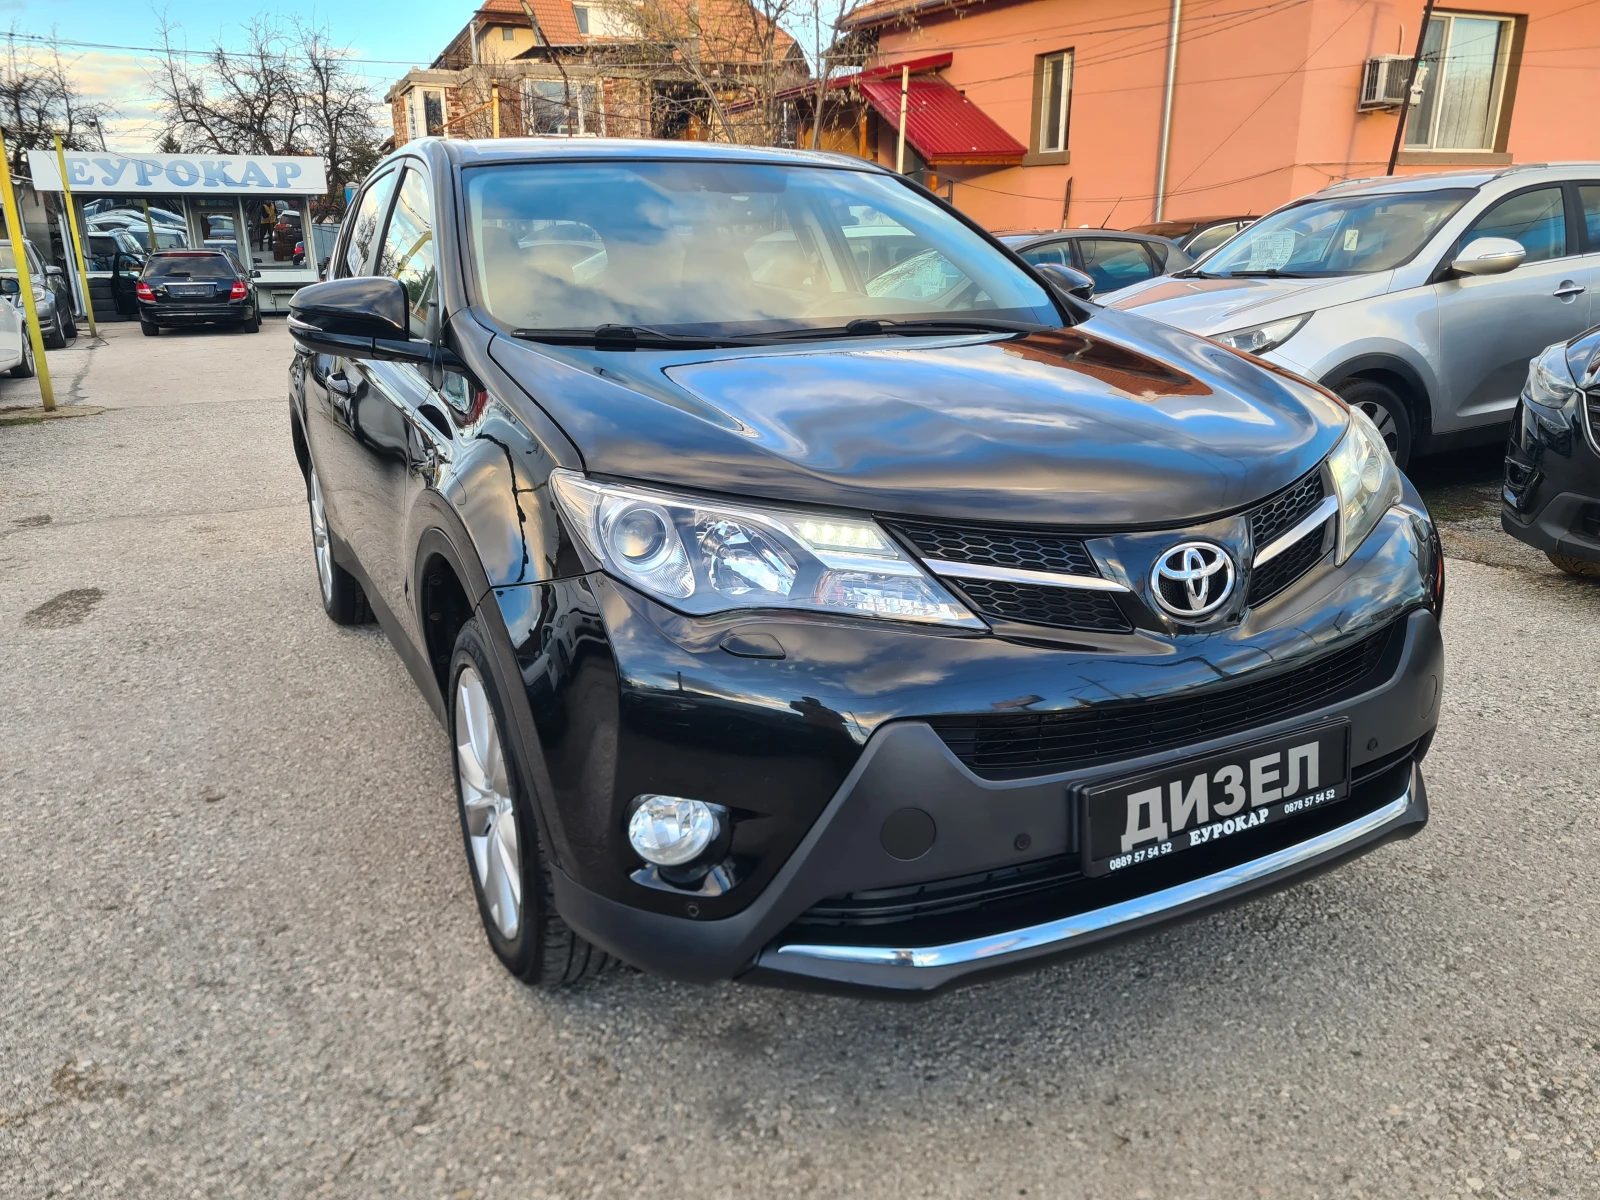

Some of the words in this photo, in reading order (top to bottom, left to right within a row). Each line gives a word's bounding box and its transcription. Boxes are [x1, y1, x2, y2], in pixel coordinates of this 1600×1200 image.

[66, 157, 302, 188] ЕУРОКАР
[1109, 854, 1132, 871] 0889
[1133, 850, 1146, 863] 57
[1147, 845, 1159, 859] 54
[1160, 842, 1173, 855] 52
[1189, 808, 1269, 847] ЕУРОКАР
[1284, 801, 1303, 814] 0878
[1304, 796, 1314, 808] 57
[1315, 793, 1325, 804] 54
[1325, 788, 1336, 800] 52
[1120, 741, 1320, 854] ДИЗЕЛ
